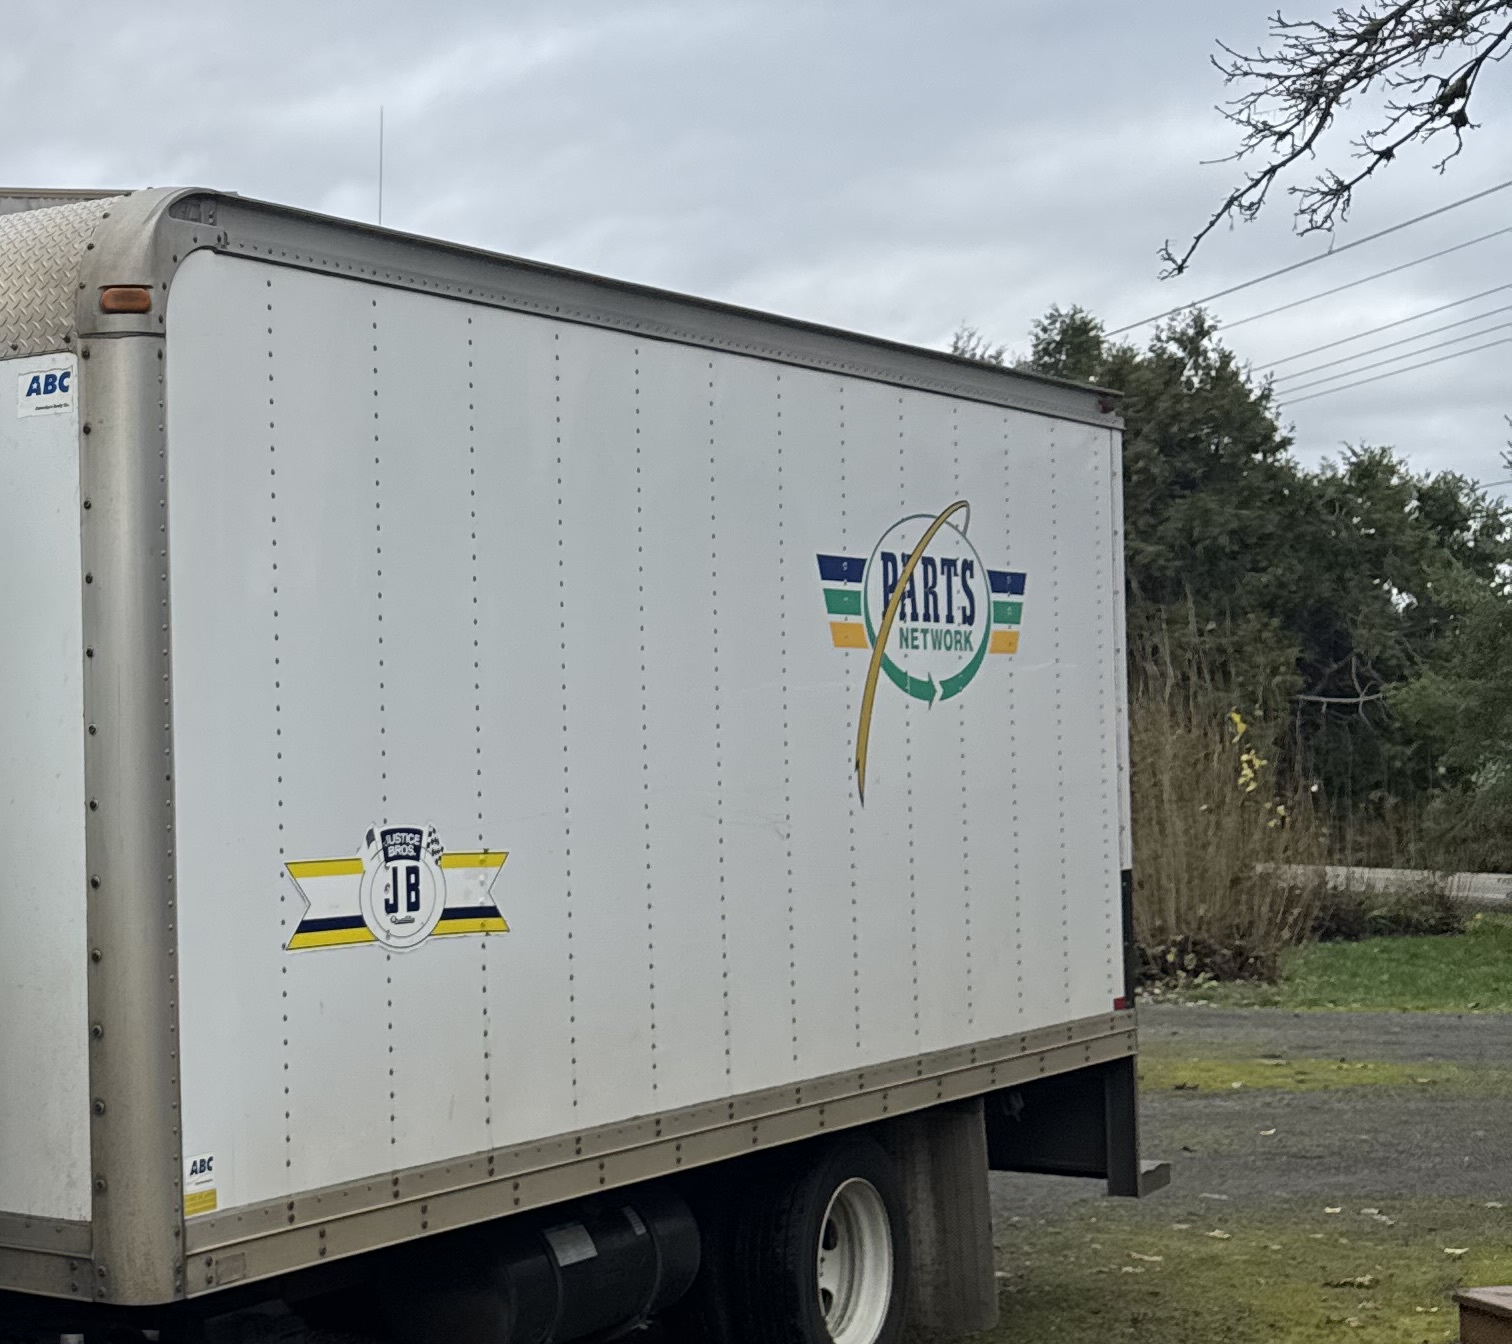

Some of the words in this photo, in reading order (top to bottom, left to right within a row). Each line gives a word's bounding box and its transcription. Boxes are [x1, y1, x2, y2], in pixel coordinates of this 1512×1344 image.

[25, 370, 72, 397] ABC
[880, 551, 976, 627] PARTS
[898, 627, 974, 652] NETWORK
[382, 831, 421, 847] JUSTICE
[387, 844, 417, 858] BROS.
[384, 864, 421, 914] JB
[189, 1155, 214, 1176] ABC
